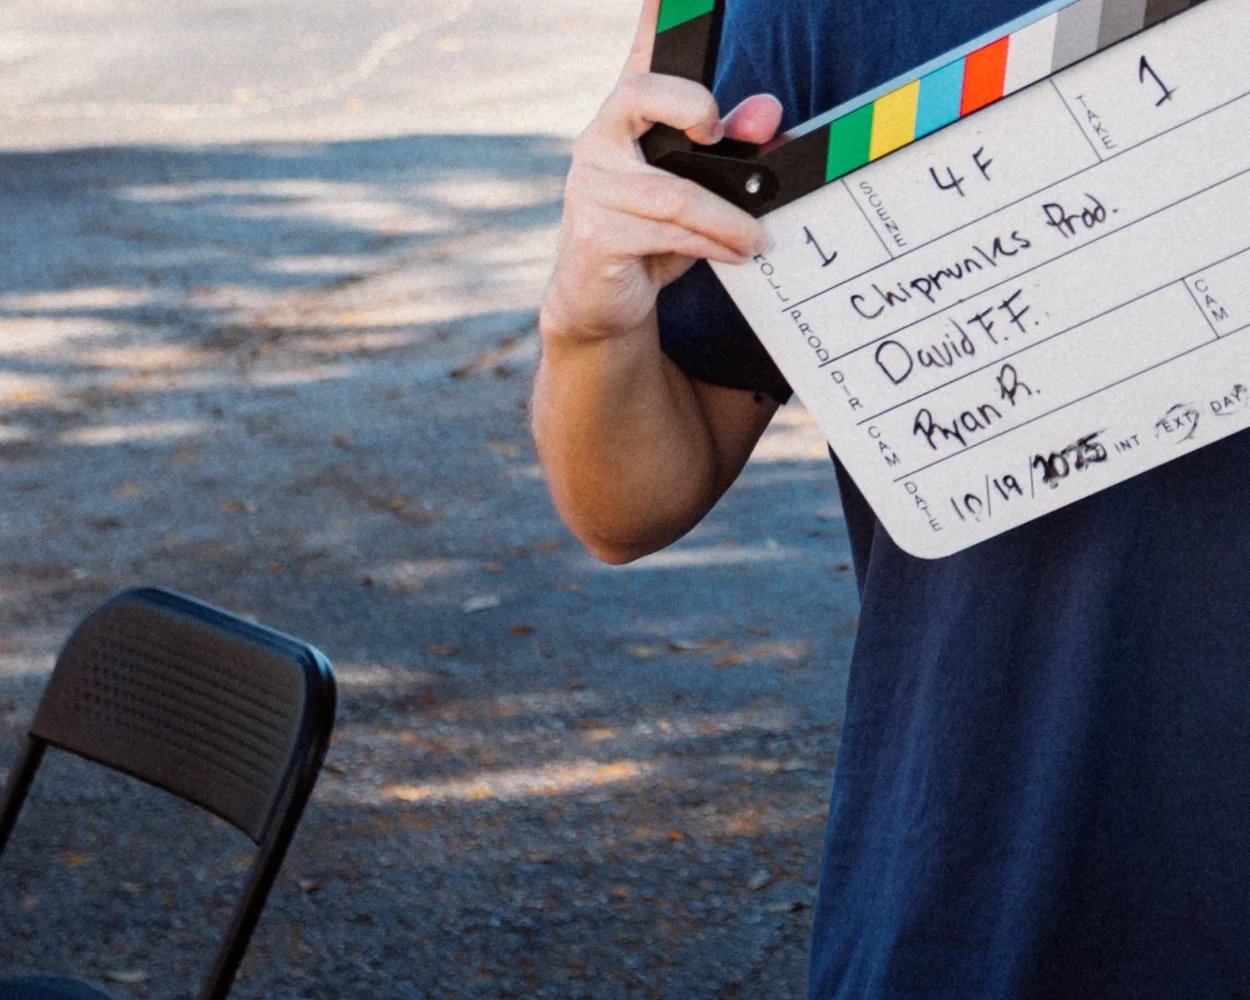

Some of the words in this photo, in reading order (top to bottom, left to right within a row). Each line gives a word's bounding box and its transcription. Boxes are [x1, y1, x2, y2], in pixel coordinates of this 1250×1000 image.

[1138, 54, 1178, 107] 1
[1075, 94, 1116, 150] TAKE
[859, 181, 907, 249] SCENE
[803, 225, 838, 268] 1
[1194, 278, 1229, 323] CAM
[790, 310, 830, 362] PROD
[875, 318, 976, 385] David
[830, 370, 865, 412] DIR
[912, 407, 1003, 452] Ryan
[1113, 433, 1141, 454] INT
[1163, 409, 1195, 434] EXT
[1209, 385, 1244, 414] DAY
[867, 425, 901, 468] CAM
[903, 481, 943, 533] DATE
